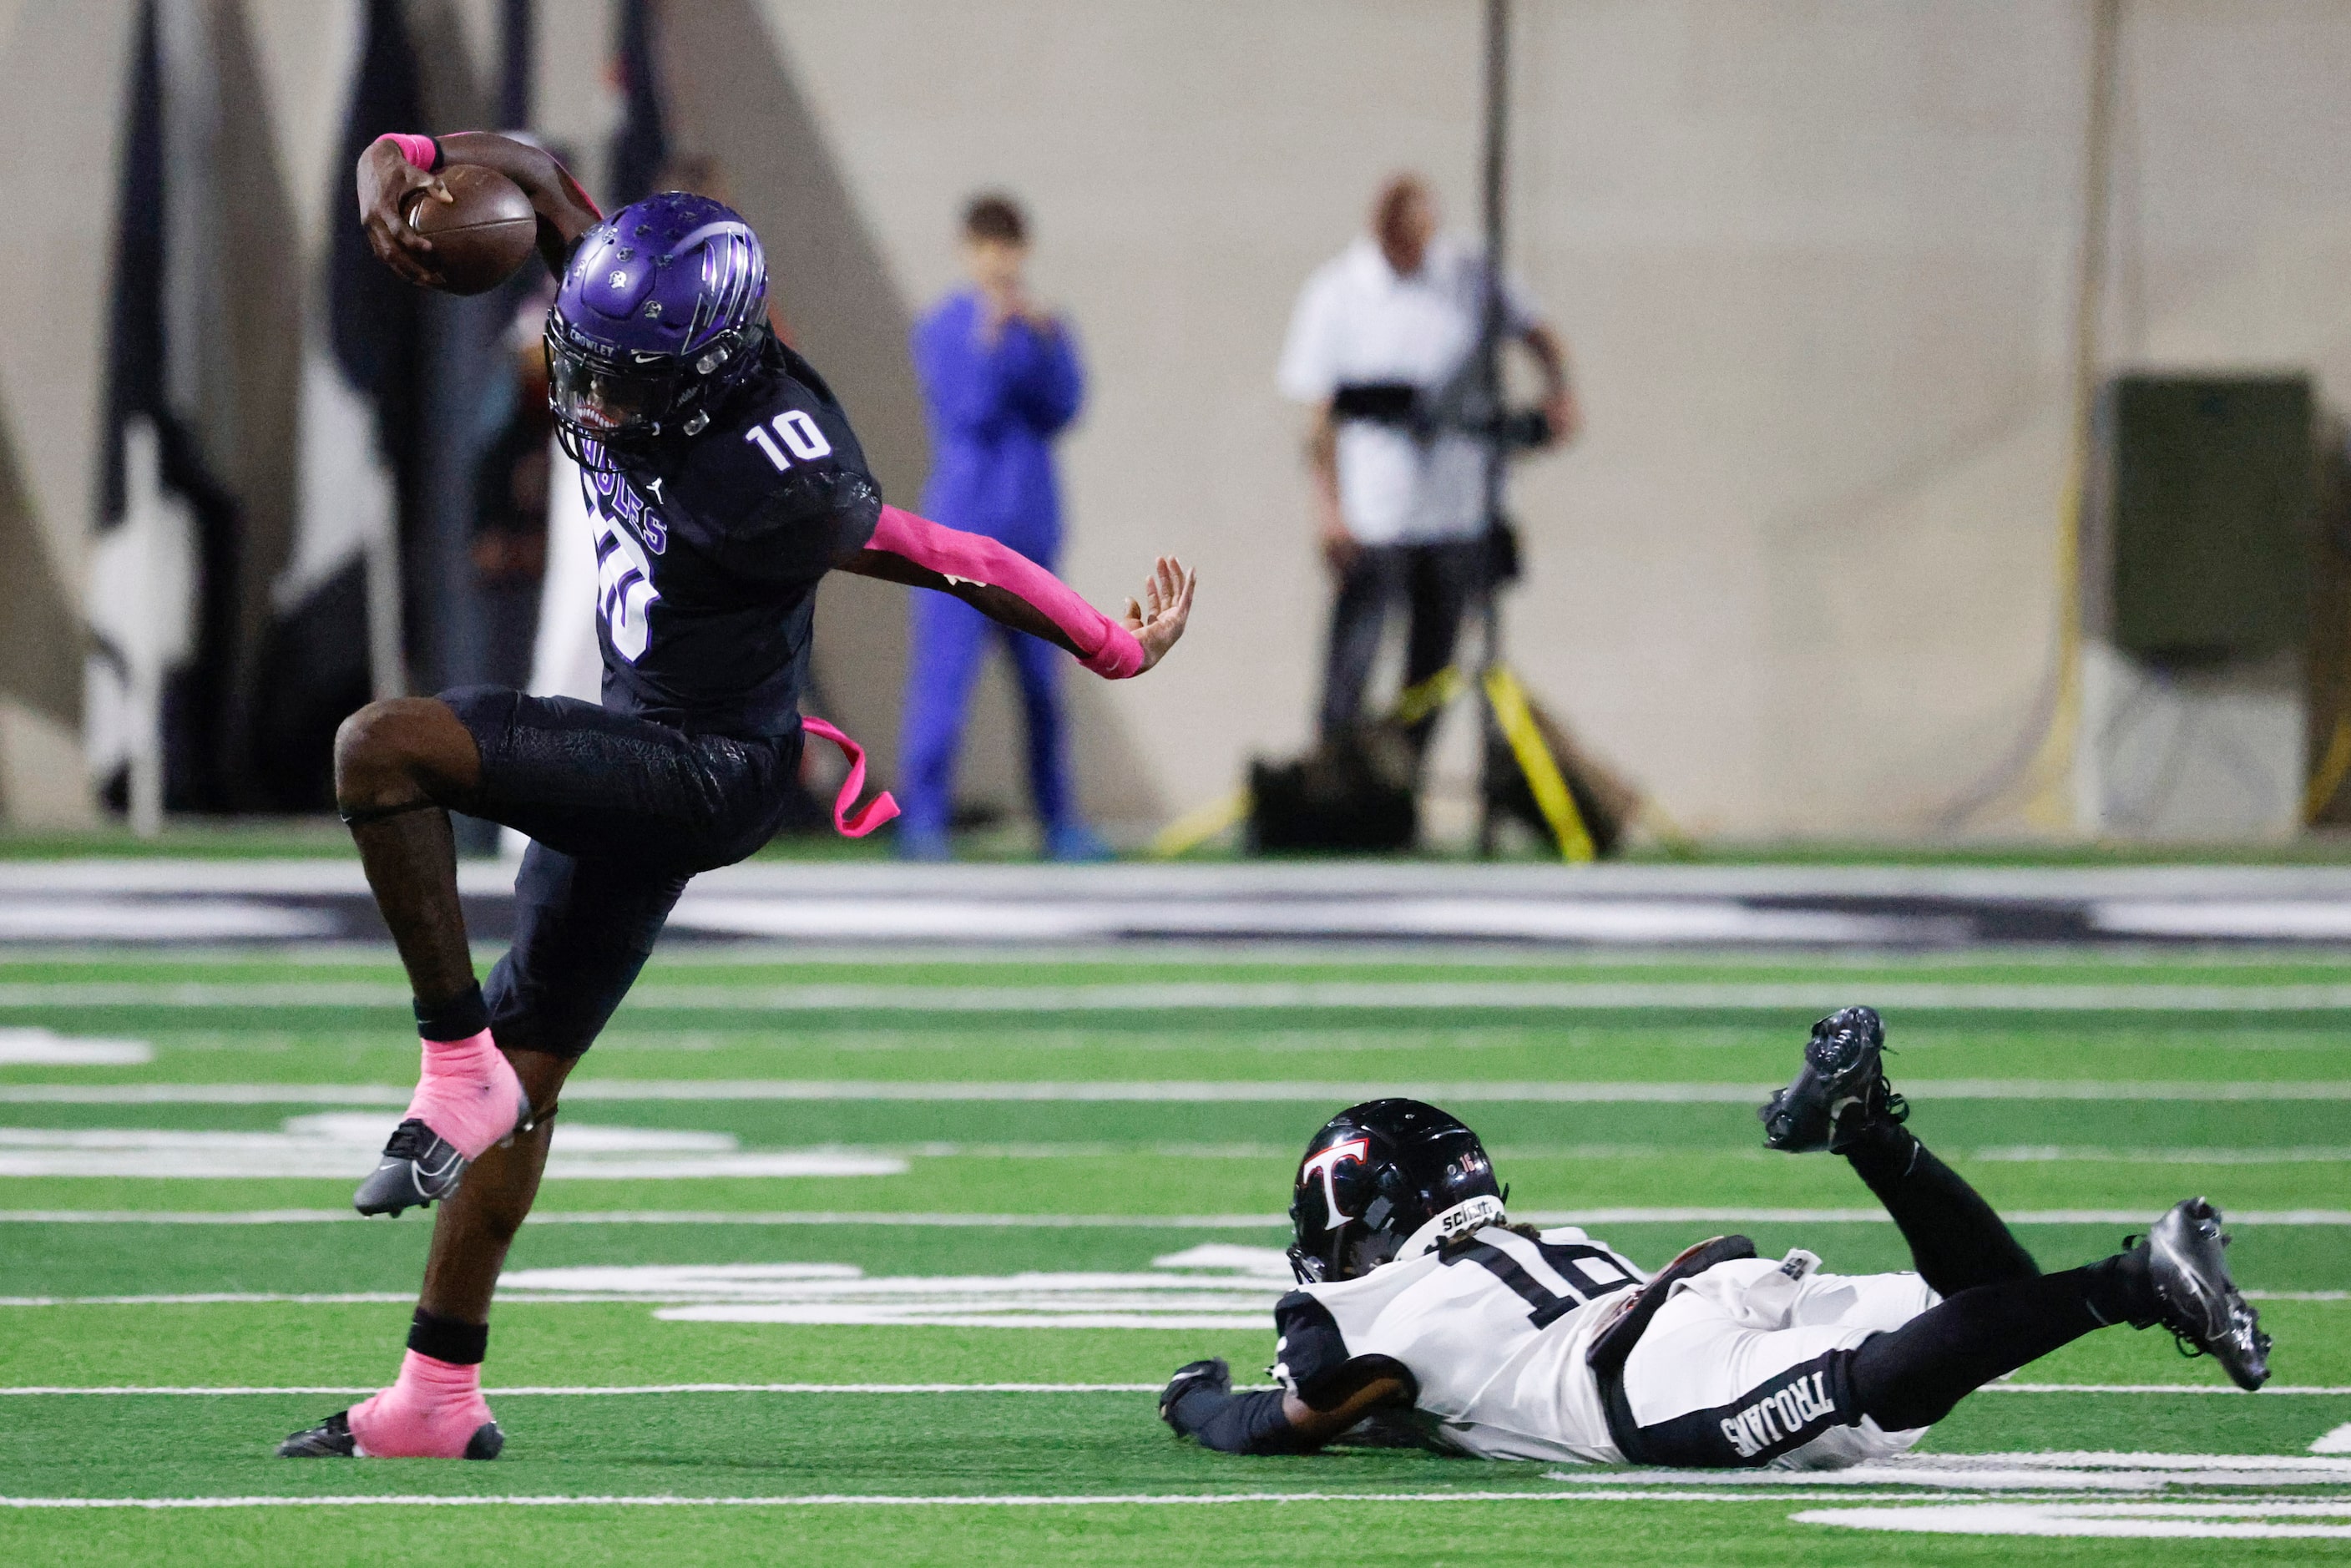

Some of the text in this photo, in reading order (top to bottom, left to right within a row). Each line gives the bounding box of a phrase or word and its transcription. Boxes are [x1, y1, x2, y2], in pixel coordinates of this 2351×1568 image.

[569, 328, 614, 357] CROWLEY
[743, 409, 833, 475] 10
[580, 428, 667, 556] AGLES
[1302, 1137, 1370, 1232] T
[1720, 1370, 1836, 1458] TROJANS
